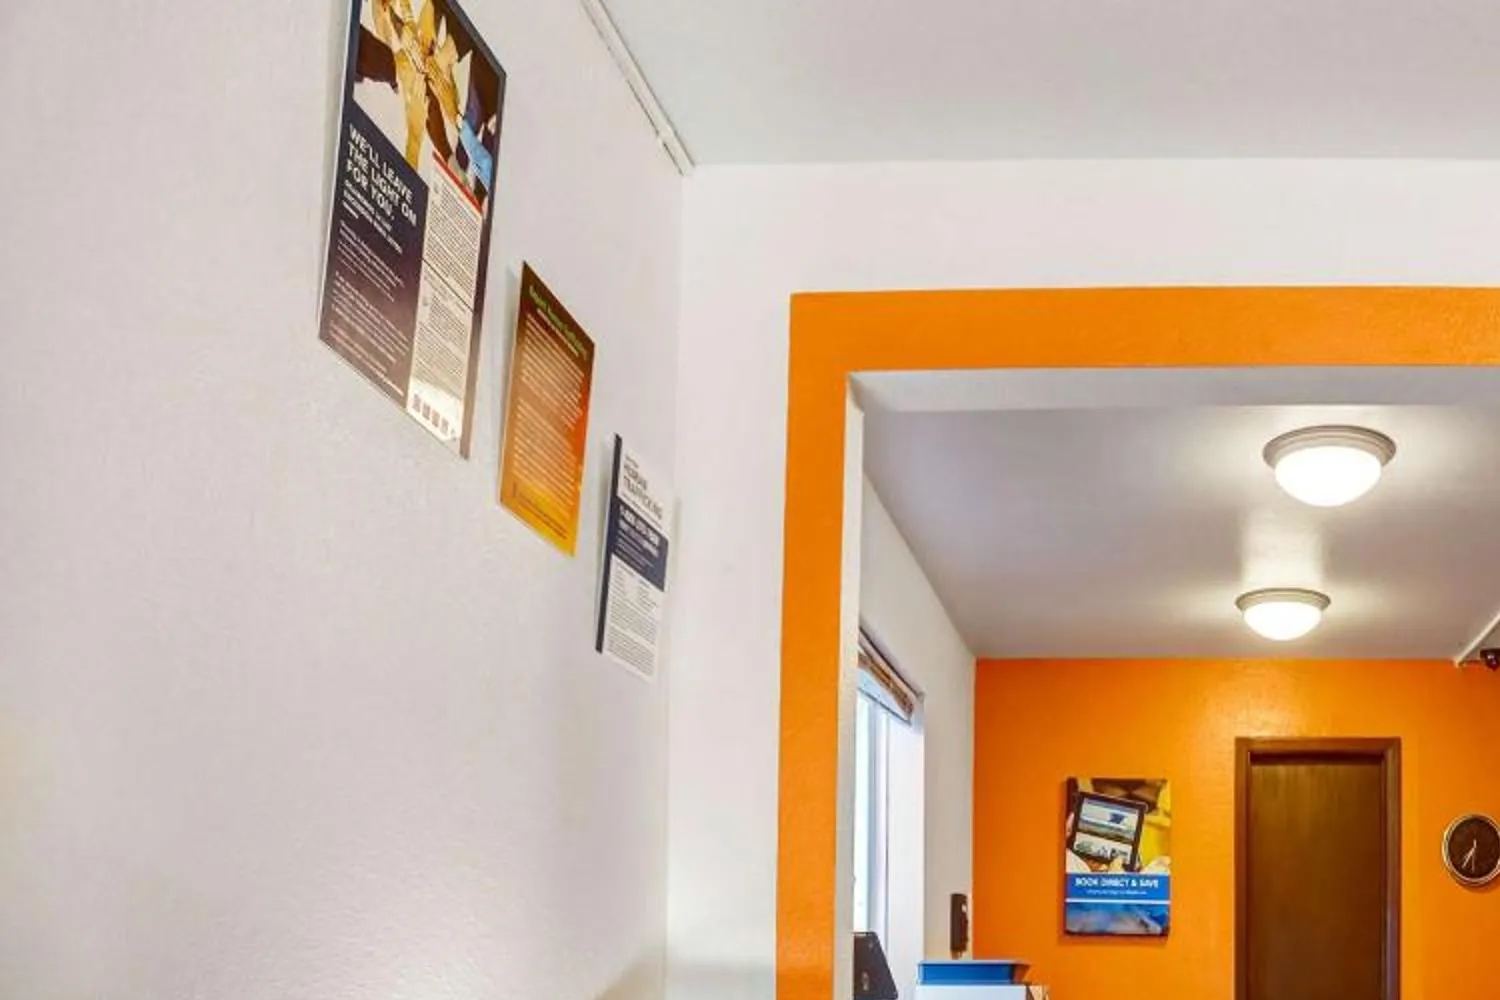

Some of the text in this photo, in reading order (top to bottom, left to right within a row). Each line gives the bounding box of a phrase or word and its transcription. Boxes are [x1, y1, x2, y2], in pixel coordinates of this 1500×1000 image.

[346, 158, 368, 191] FOR
[371, 183, 395, 221] YOU.
[347, 140, 369, 174] THE
[371, 167, 399, 207] LIGHT
[401, 203, 417, 227] ON
[349, 123, 380, 169] WE'LL
[383, 162, 413, 205] LEAVE
[1075, 877, 1099, 887] BOOK
[1140, 878, 1159, 888] SAVE
